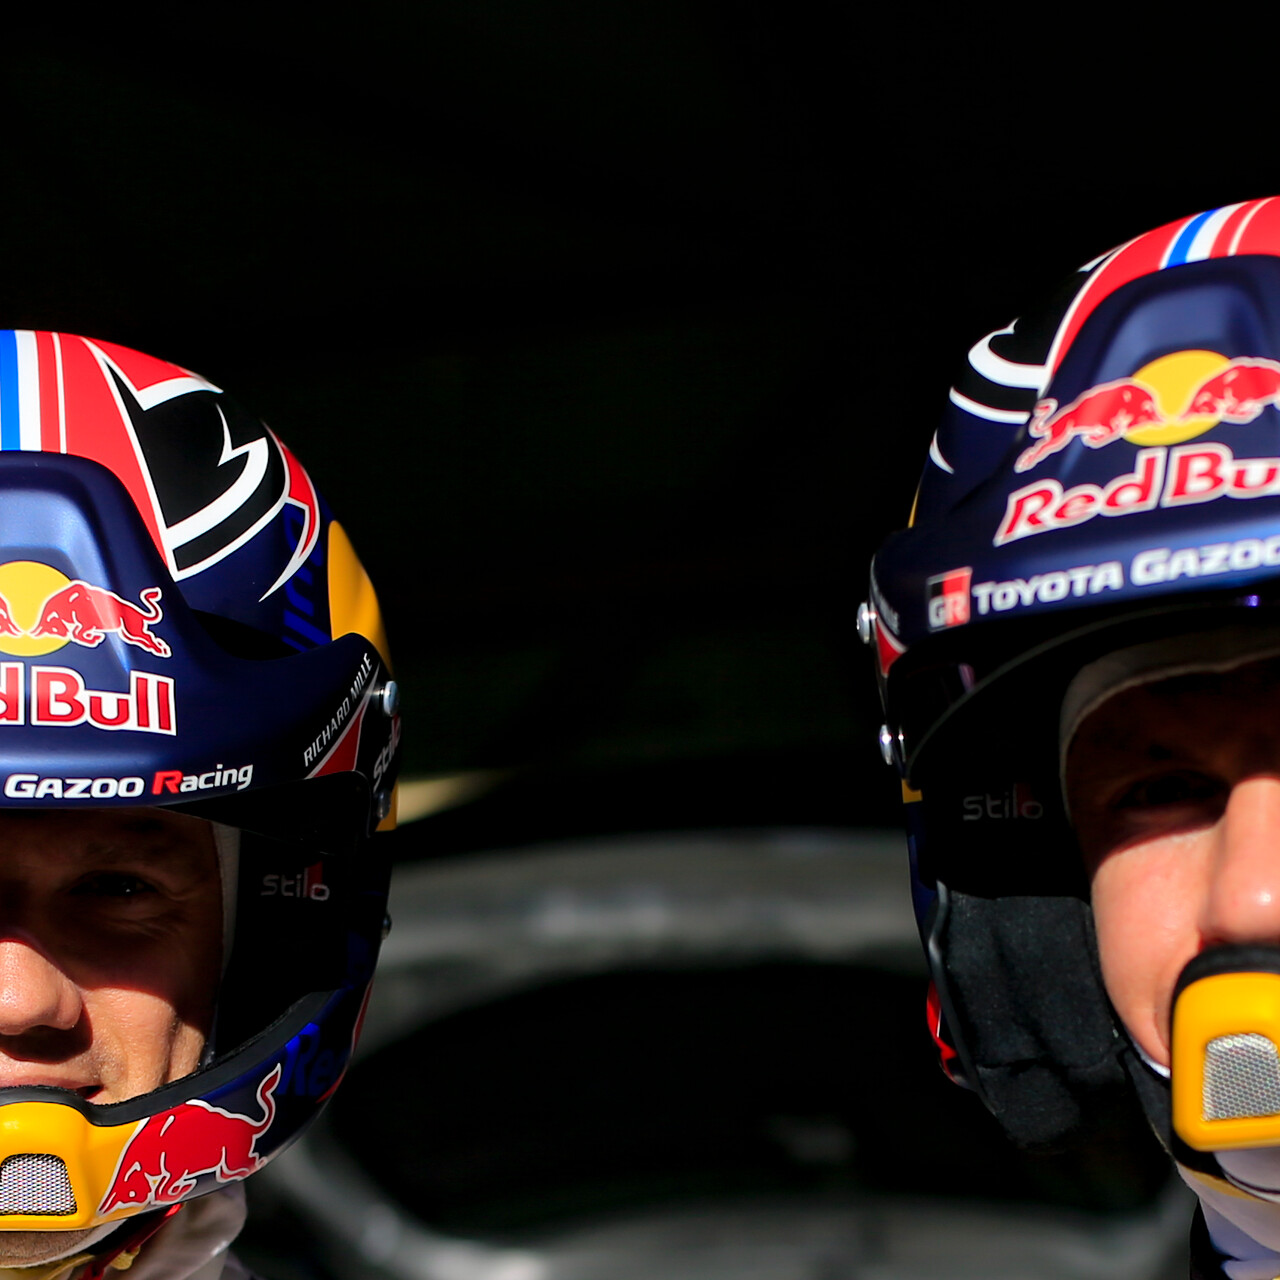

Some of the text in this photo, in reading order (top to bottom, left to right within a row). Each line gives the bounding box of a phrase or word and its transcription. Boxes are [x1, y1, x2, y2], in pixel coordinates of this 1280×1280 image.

[993, 446, 1167, 547] Red
[971, 562, 1122, 616] TOYOTA
[30, 665, 177, 736] Bull
[303, 653, 373, 768] RICHARD MILLE
[4, 774, 144, 799] GAZOO
[152, 764, 254, 796] Racing
[962, 782, 1044, 822] Stilo
[260, 866, 331, 902] Stilo
